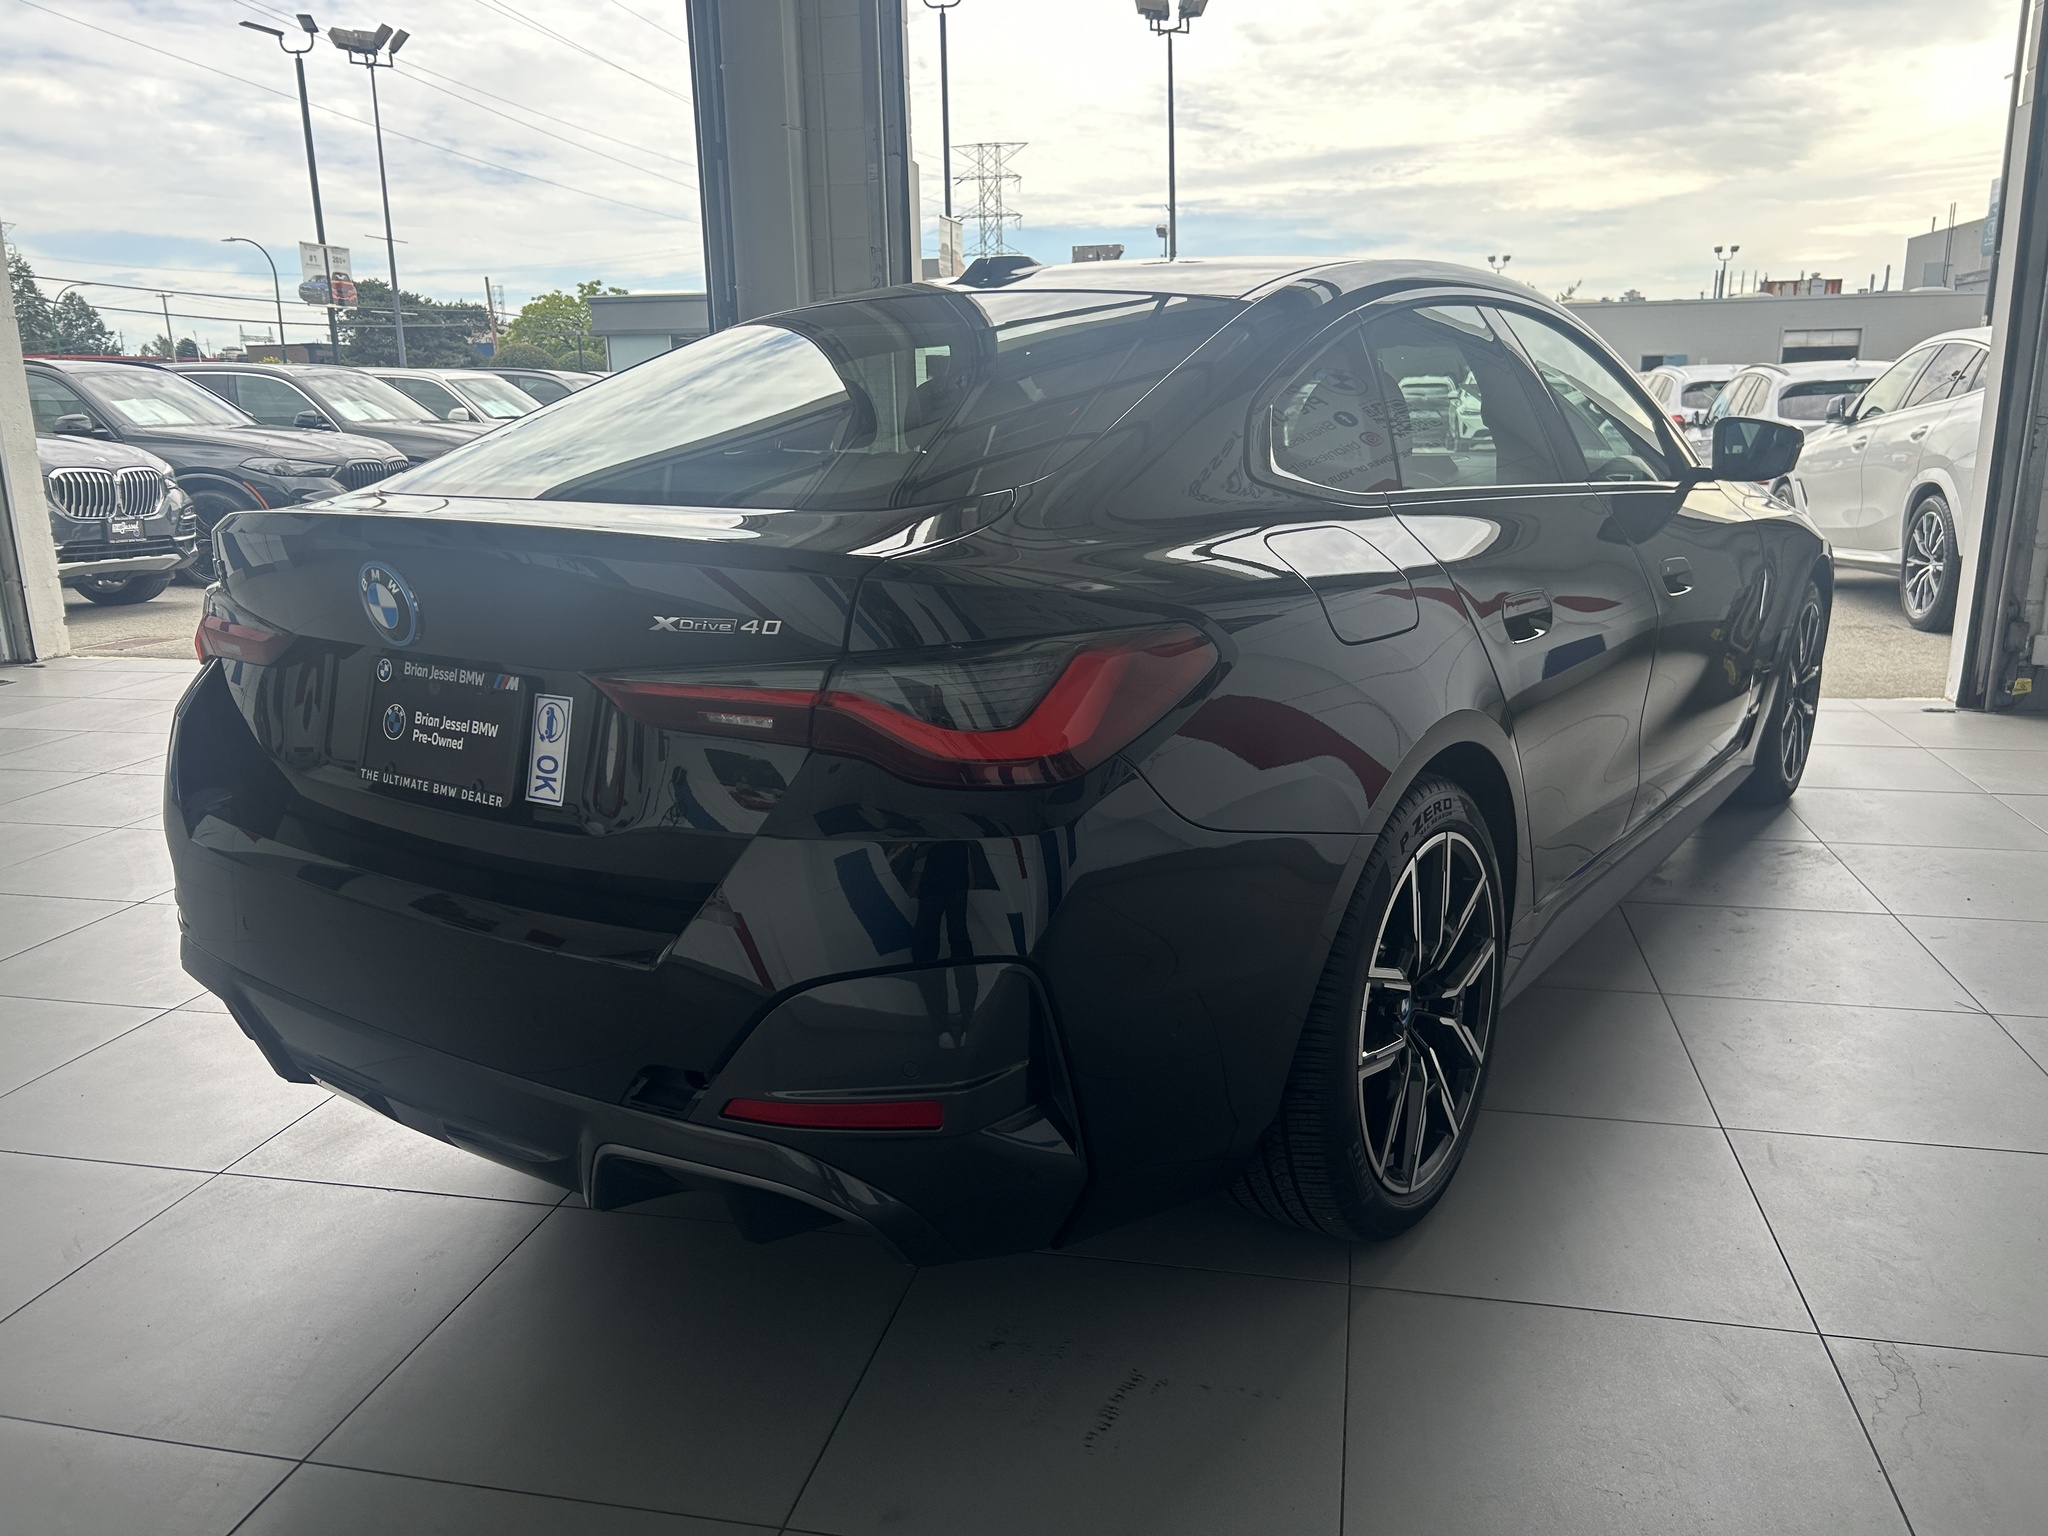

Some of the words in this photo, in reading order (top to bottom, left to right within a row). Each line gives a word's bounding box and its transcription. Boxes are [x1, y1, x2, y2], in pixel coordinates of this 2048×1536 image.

[360, 569, 400, 593] BMW
[740, 619, 782, 635] 40
[404, 662, 428, 678] Brian
[429, 665, 458, 682] Jessel
[459, 669, 485, 686] BMW
[414, 711, 440, 727] Brian
[440, 715, 470, 733] Jessel
[471, 720, 499, 738] BMW
[412, 729, 464, 750] Pre-Owned
[360, 768, 379, 782] THE
[382, 773, 429, 792] ULTIMATE
[433, 783, 457, 798] BMW
[461, 789, 503, 807] DEALER
[535, 755, 559, 795] OK
[1400, 831, 1409, 855] P
[1412, 797, 1453, 836] ZERO
